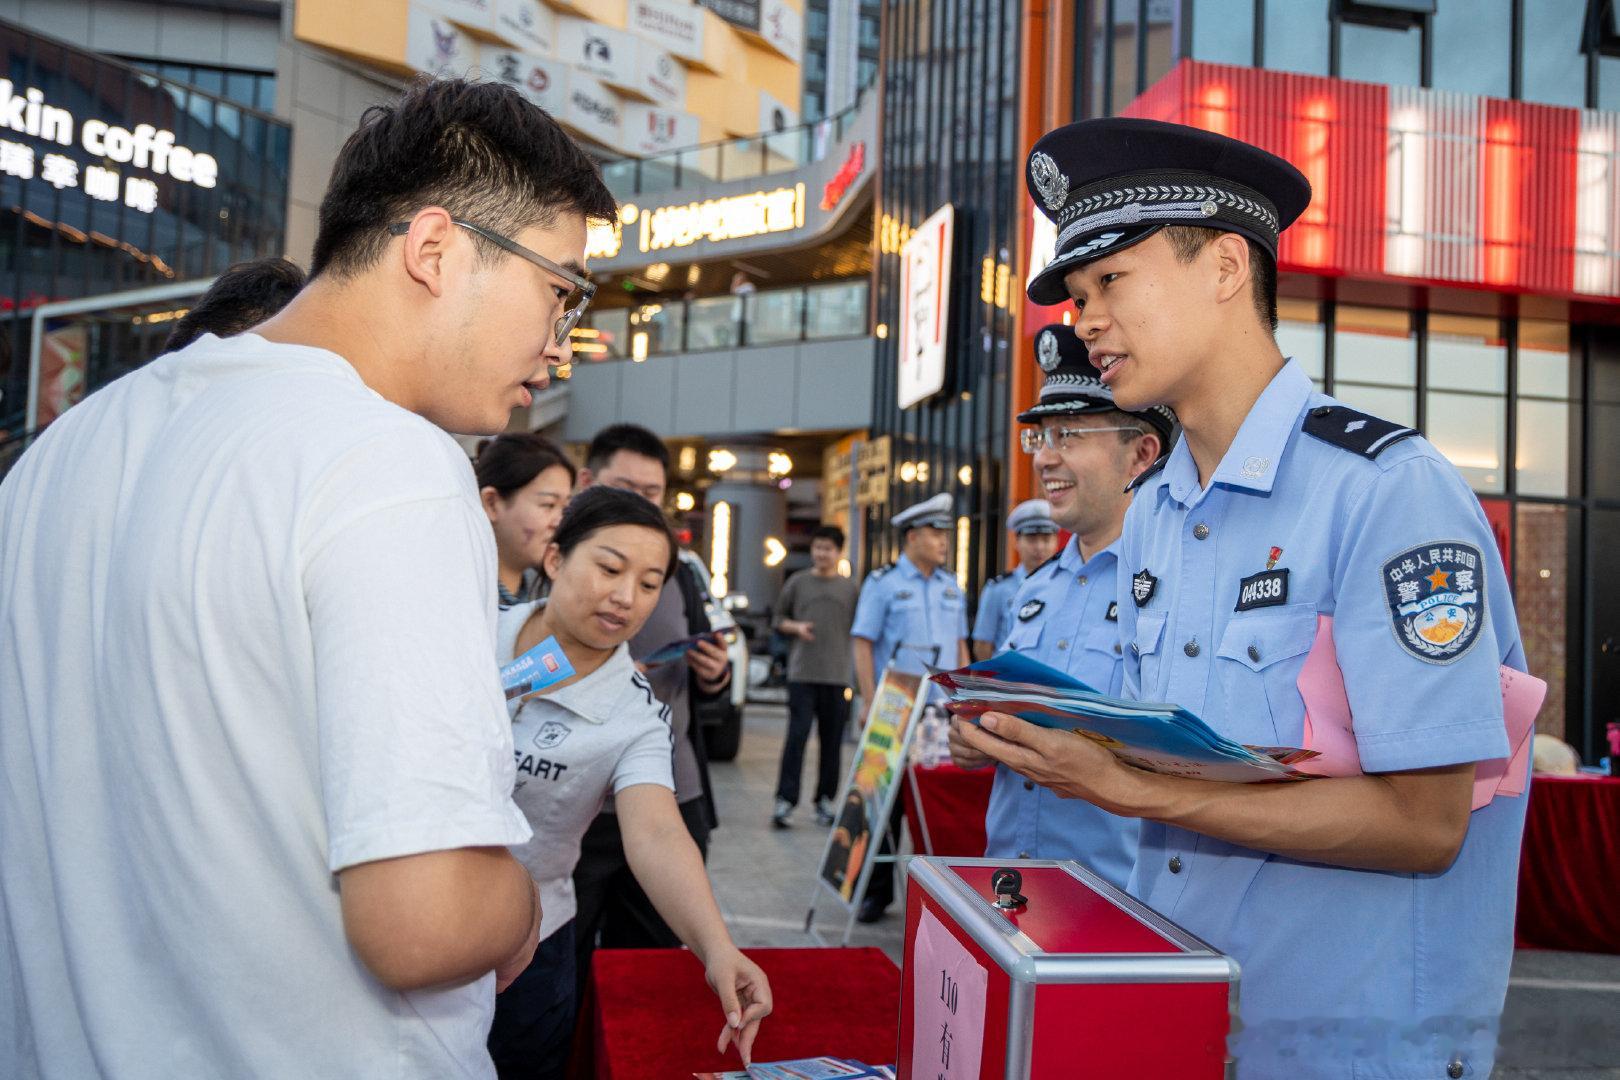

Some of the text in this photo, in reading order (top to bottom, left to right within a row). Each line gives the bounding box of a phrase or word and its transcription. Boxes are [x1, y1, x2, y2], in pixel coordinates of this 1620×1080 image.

[81, 118, 218, 189] coffee
[1390, 548, 1475, 581] 中华人民共和国
[1241, 577, 1281, 604] 044338
[1420, 594, 1459, 609] POLICE
